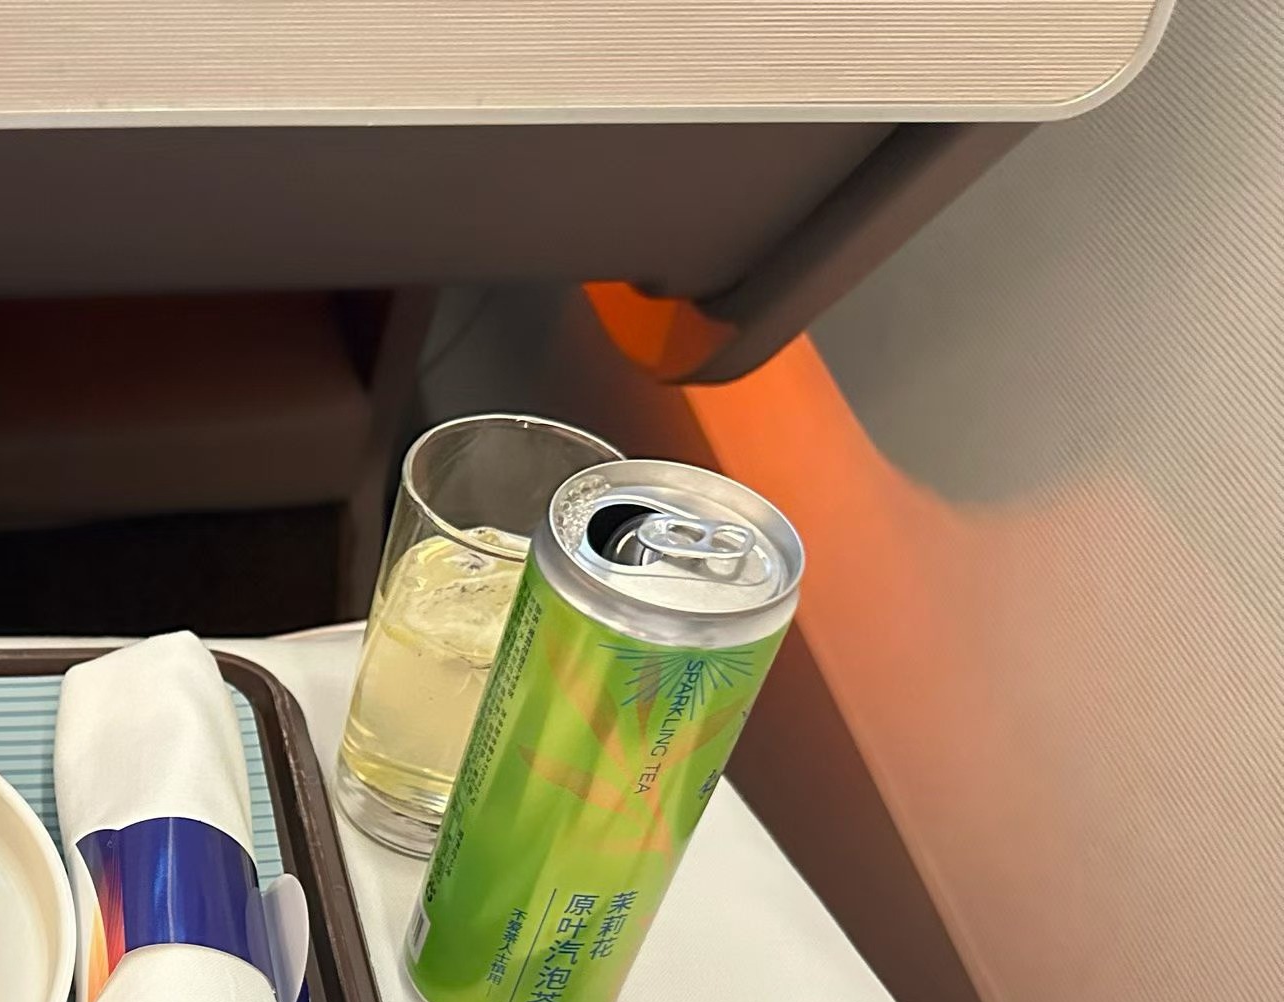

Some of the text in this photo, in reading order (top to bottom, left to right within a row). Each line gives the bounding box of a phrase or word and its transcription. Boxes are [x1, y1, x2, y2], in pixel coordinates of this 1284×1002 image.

[633, 659, 704, 794] SPARKLING TEA
[589, 890, 639, 960] 茉莉花
